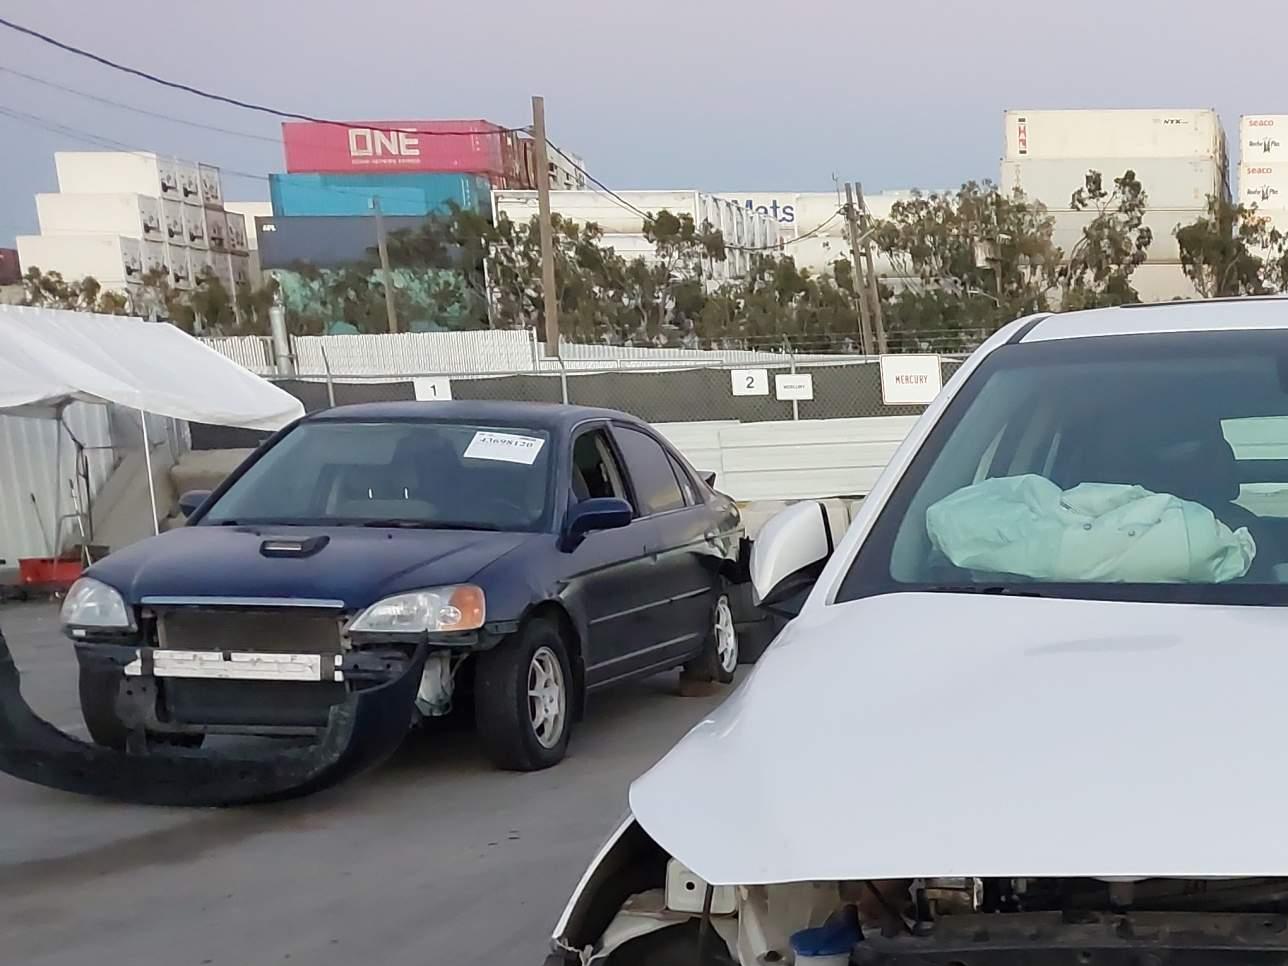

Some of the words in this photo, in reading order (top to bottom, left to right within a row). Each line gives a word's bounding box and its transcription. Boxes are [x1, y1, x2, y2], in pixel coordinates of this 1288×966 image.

[348, 128, 420, 156] ONE
[1247, 166, 1273, 175] seaco
[745, 376, 755, 389] 2
[894, 374, 929, 385] MERCURY
[429, 384, 437, 397] 1
